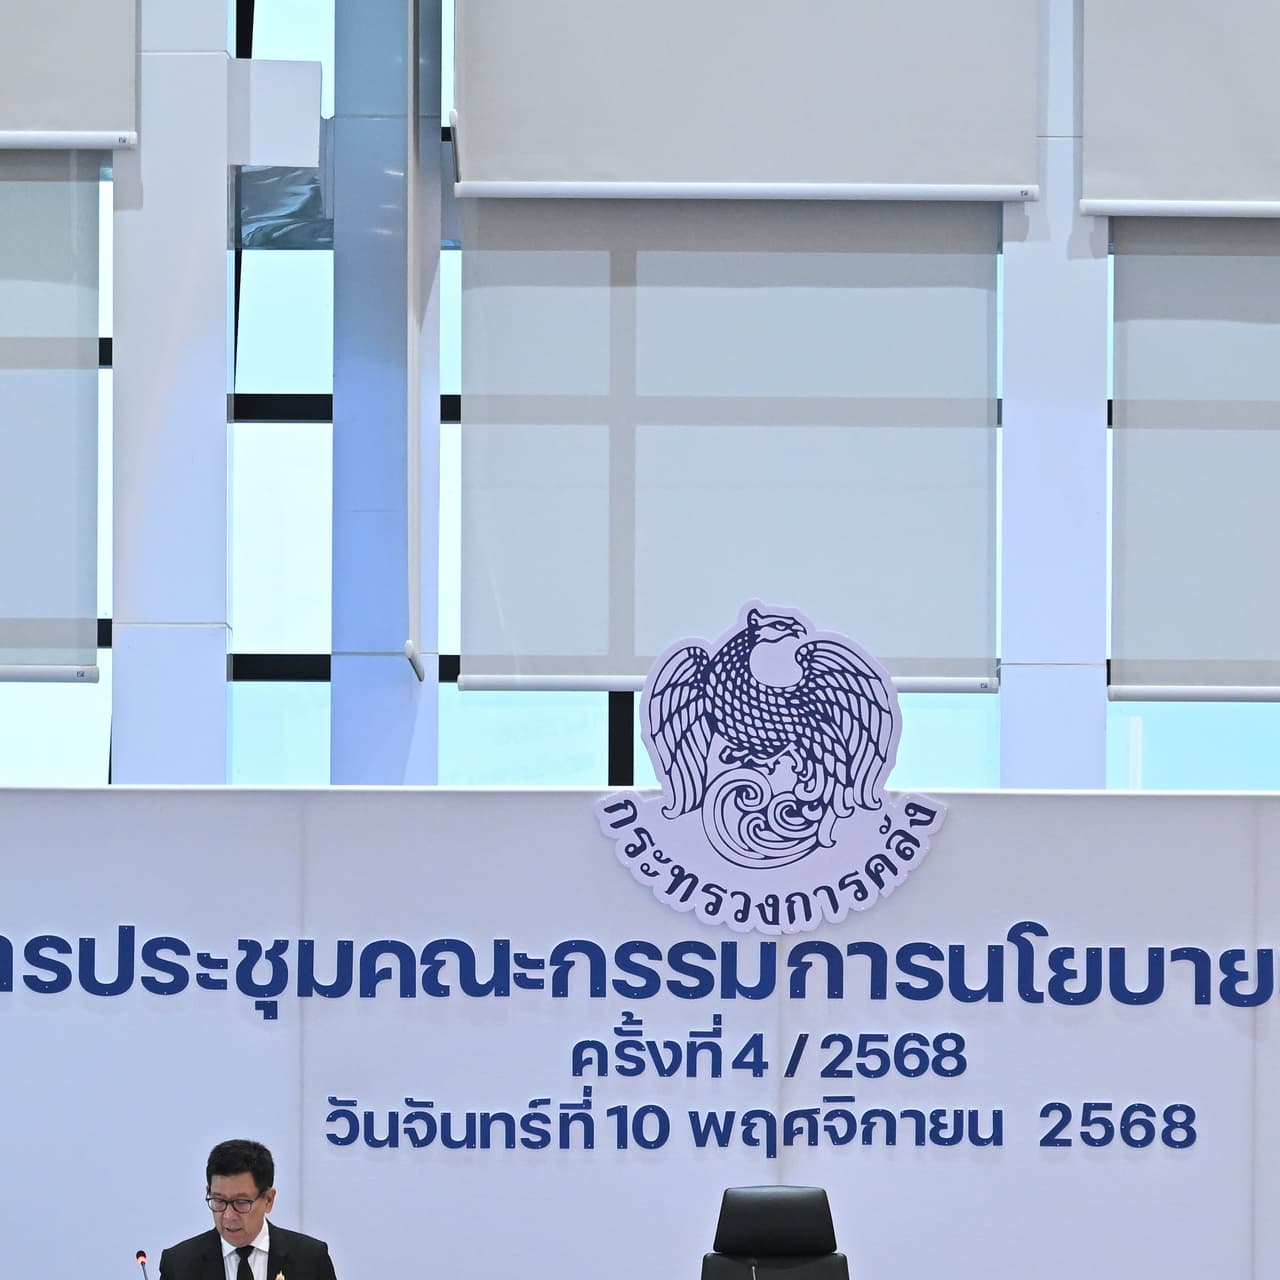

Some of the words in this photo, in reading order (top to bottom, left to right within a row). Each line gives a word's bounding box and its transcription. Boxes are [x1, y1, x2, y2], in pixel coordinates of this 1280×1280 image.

[603, 798, 938, 926] กระทรวงการคลัง
[571, 1011, 723, 1079] ครั้งที่
[731, 1032, 769, 1078] 4
[820, 1031, 968, 1079] 2568
[325, 1085, 596, 1150] วันจันทร์ที่
[605, 1104, 671, 1150] 10
[687, 1095, 1004, 1159] พฤศจิกายน
[1038, 1102, 1198, 1149] 2568
